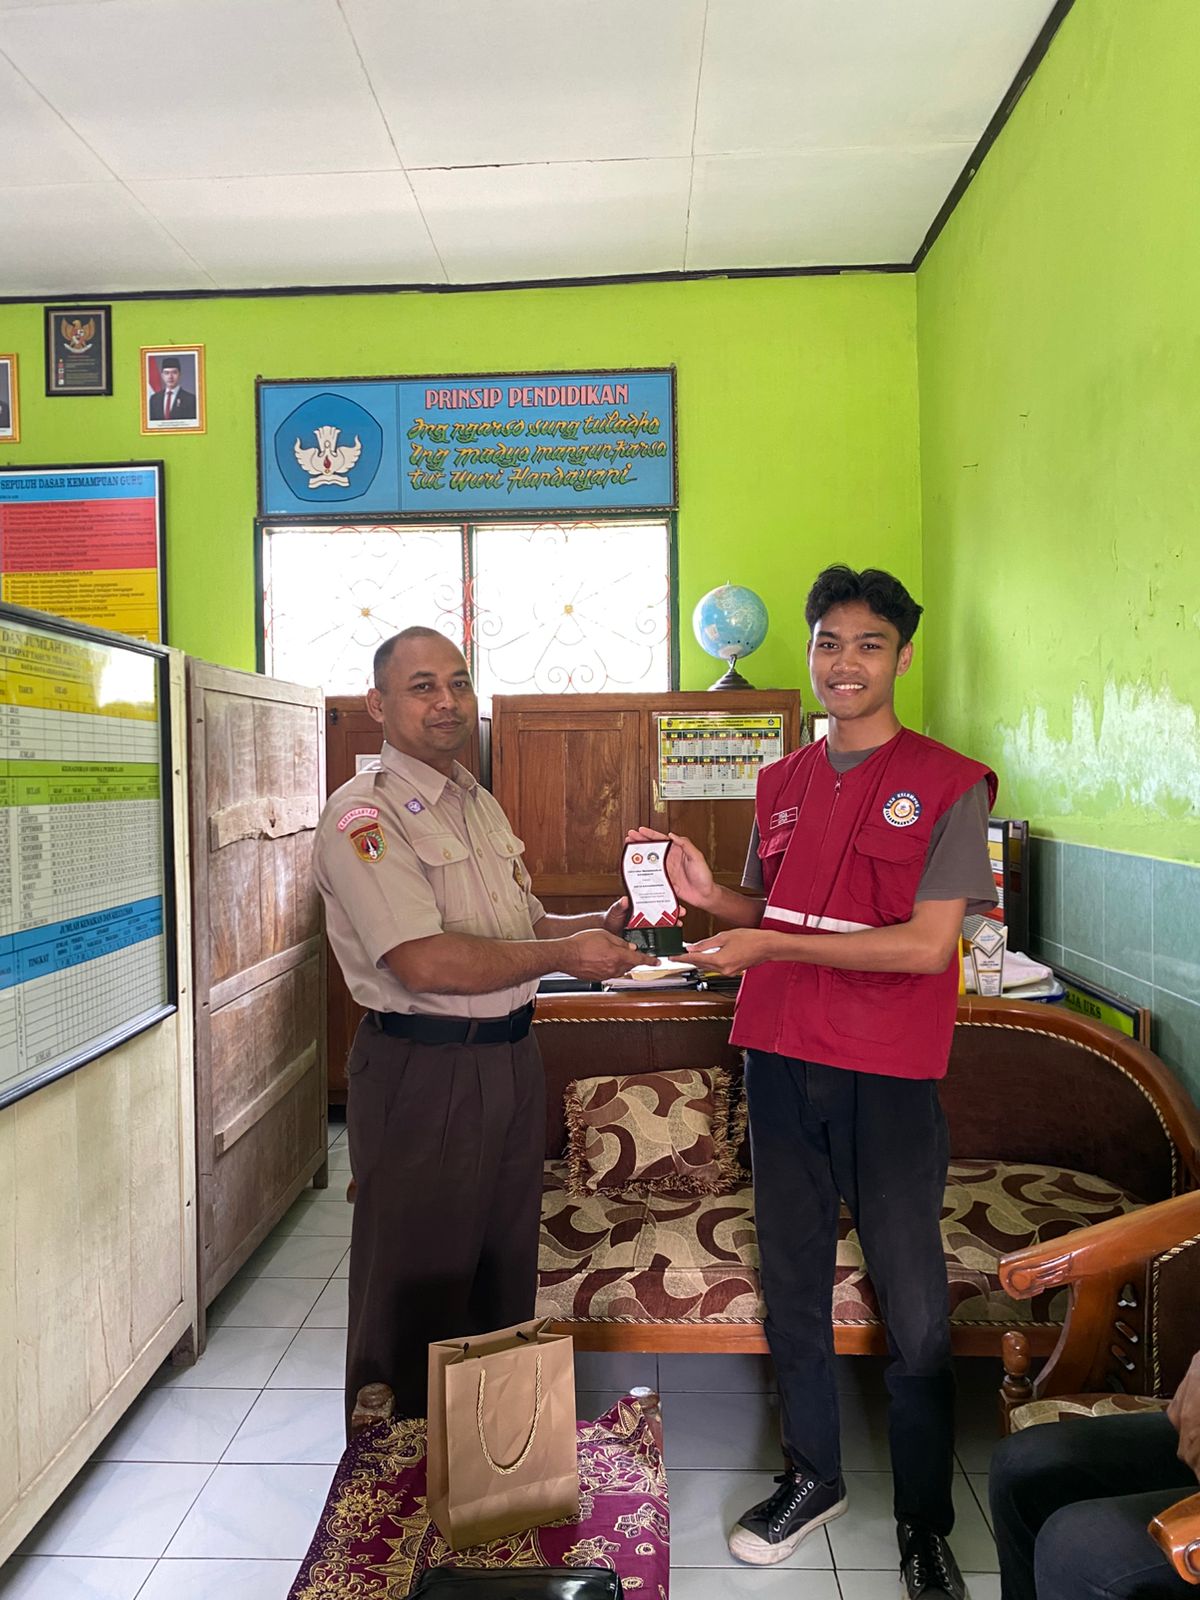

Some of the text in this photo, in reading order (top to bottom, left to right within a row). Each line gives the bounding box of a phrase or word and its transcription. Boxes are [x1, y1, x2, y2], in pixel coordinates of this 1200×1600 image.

[425, 383, 630, 410] PRINSIP PENDIDIKAN
[407, 417, 450, 444] Ing
[450, 418, 525, 444] ngarso
[525, 418, 581, 442] sung
[408, 441, 451, 471] Ing
[453, 442, 530, 468] madya
[1, 478, 37, 490] SEPULUH
[38, 477, 66, 489] DASAR
[67, 475, 119, 488] KEMAMPUAN
[507, 462, 638, 496] Handayani
[1083, 999, 1102, 1020] UKS
